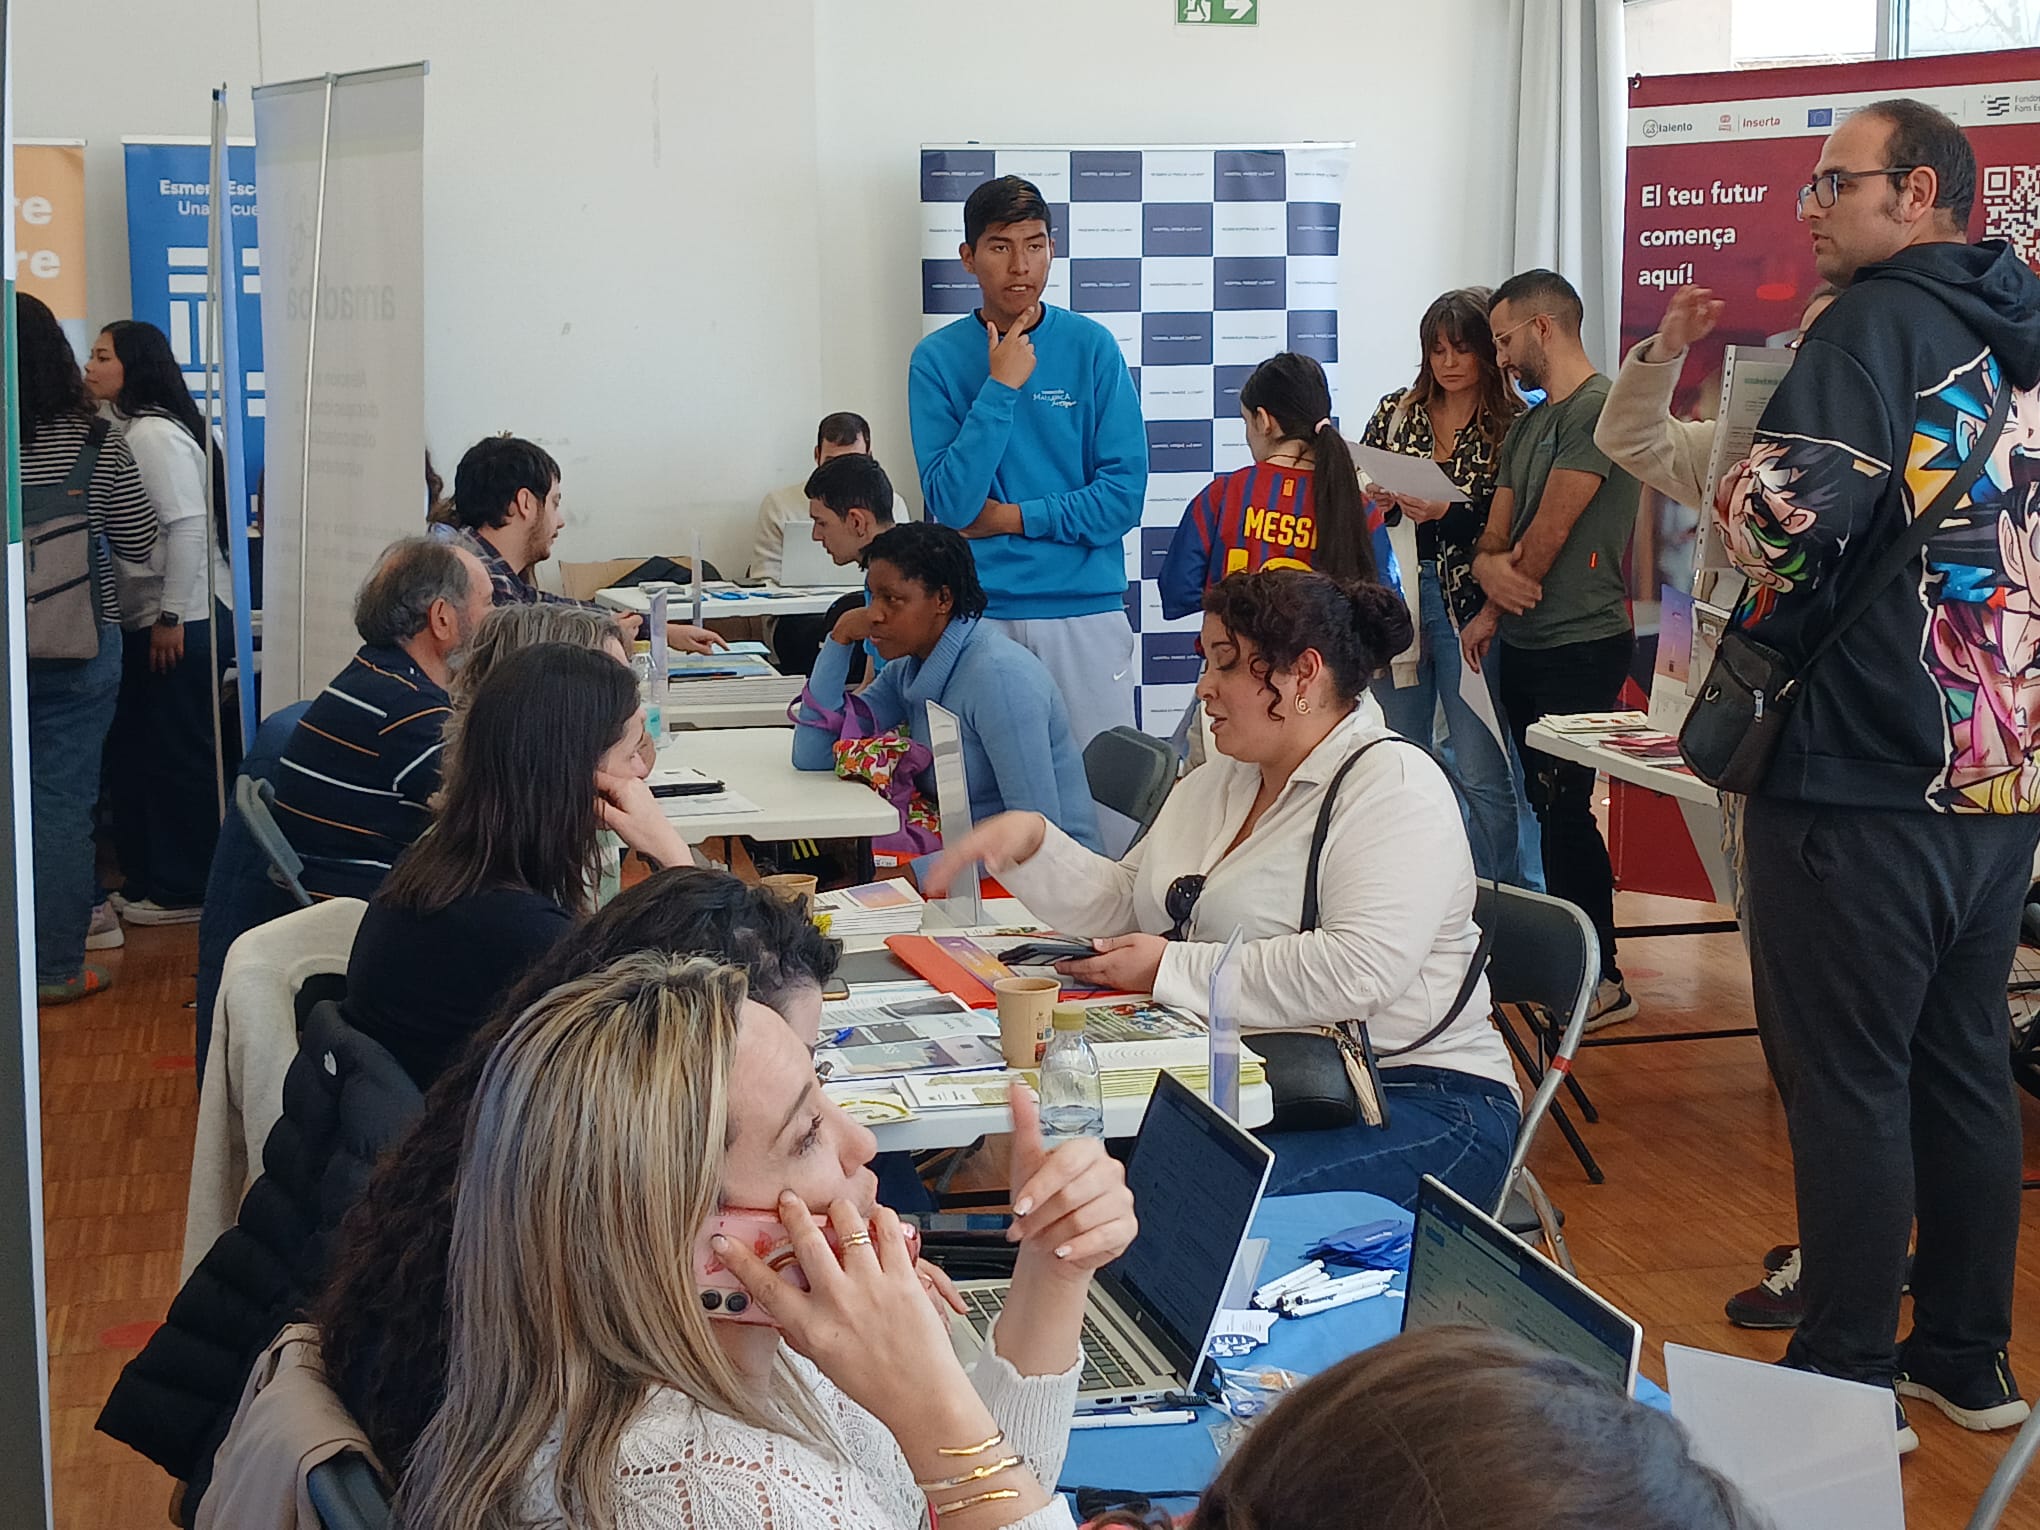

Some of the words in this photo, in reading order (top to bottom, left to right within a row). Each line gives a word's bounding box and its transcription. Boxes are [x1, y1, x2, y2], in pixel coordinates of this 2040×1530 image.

[1640, 184, 1662, 208] El
[1667, 184, 1704, 207] teu
[1710, 179, 1768, 205] futur
[178, 200, 210, 215] Una
[1638, 225, 1737, 250] comença
[1637, 262, 1694, 291] aquí!
